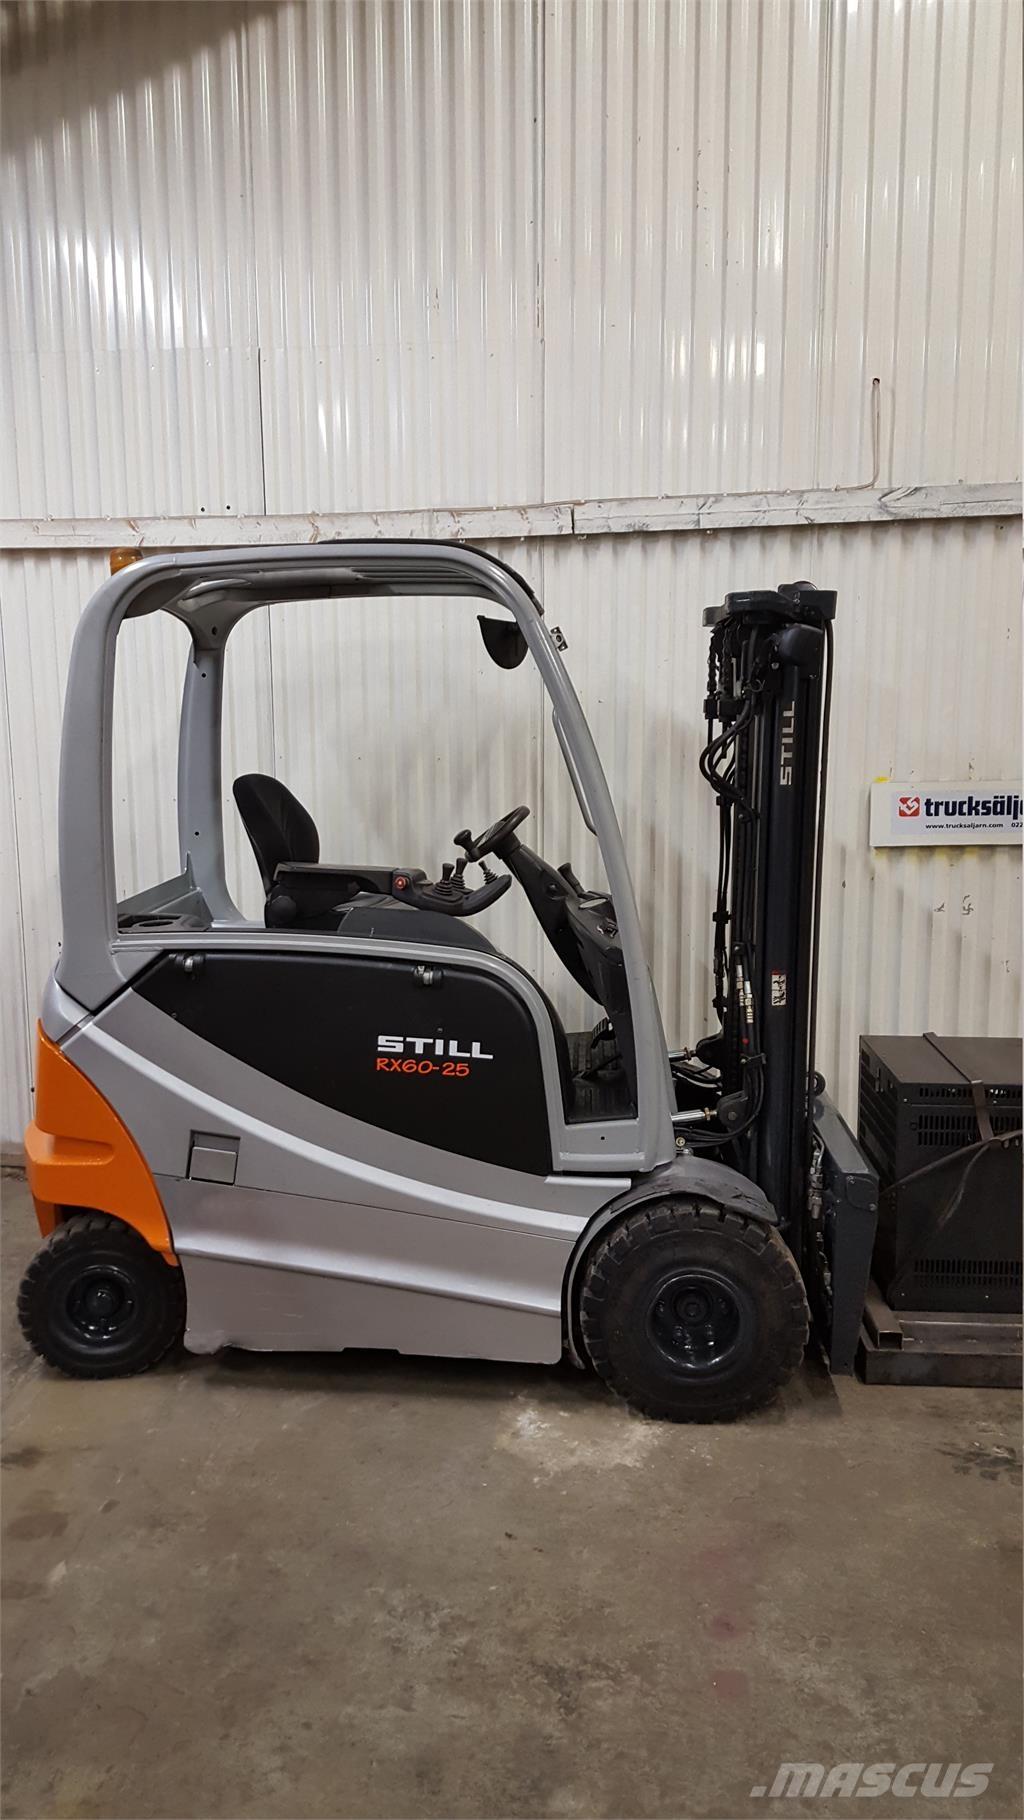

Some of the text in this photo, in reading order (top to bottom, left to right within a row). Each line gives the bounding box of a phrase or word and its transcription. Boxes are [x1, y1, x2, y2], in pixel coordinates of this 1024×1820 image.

[780, 701, 795, 785] STILL
[924, 795, 1023, 820] trucksälj
[377, 1035, 494, 1060] STILL
[376, 1057, 470, 1077] RX60-25
